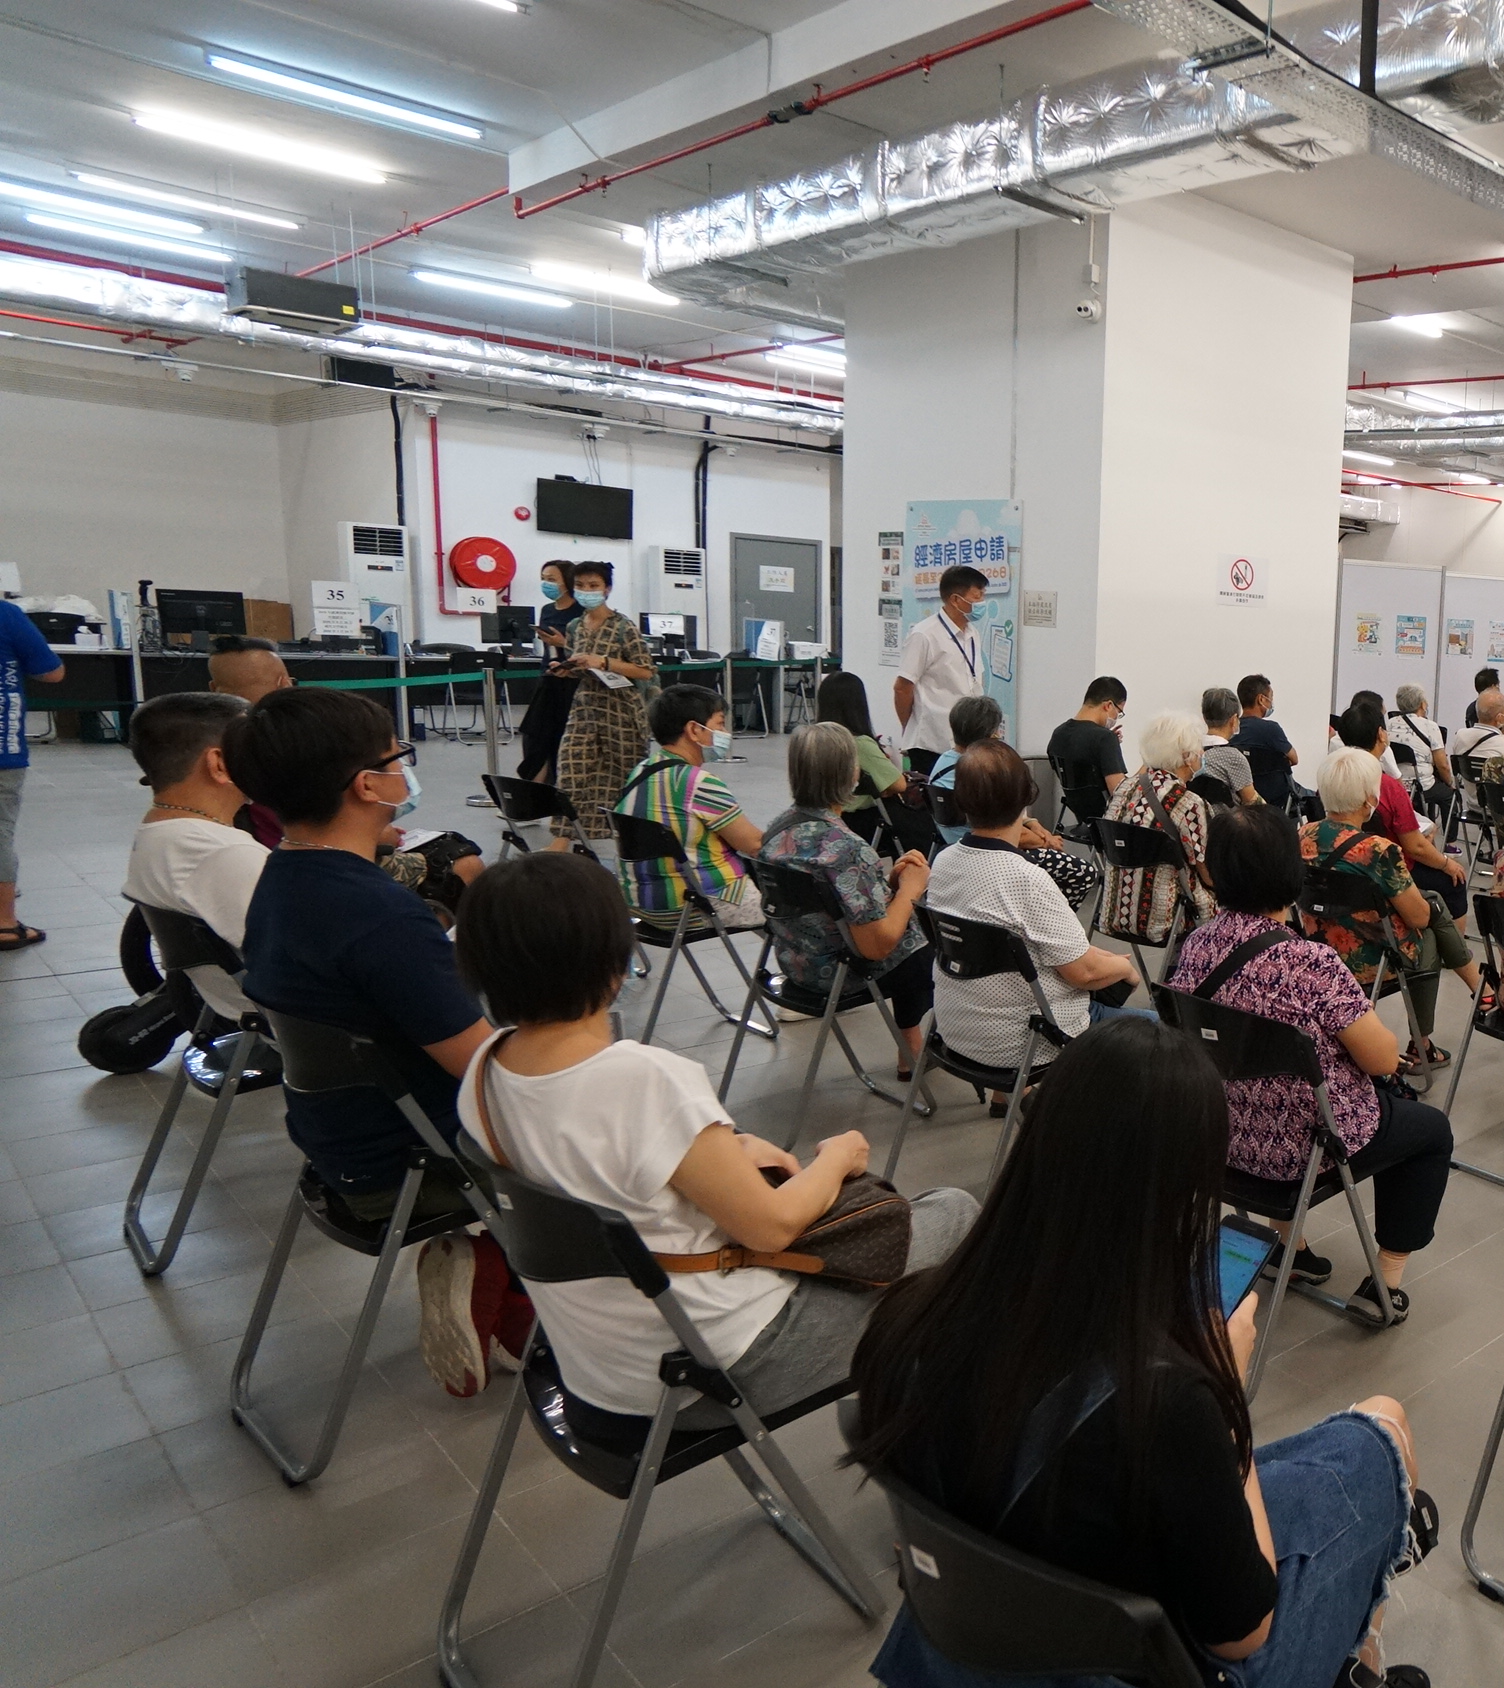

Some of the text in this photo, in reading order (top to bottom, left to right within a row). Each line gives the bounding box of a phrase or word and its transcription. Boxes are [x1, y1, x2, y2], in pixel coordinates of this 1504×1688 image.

[914, 535, 1005, 568] 經濟房屋申請
[326, 589, 345, 601] 35
[469, 595, 485, 607] 36
[659, 620, 673, 629] 37
